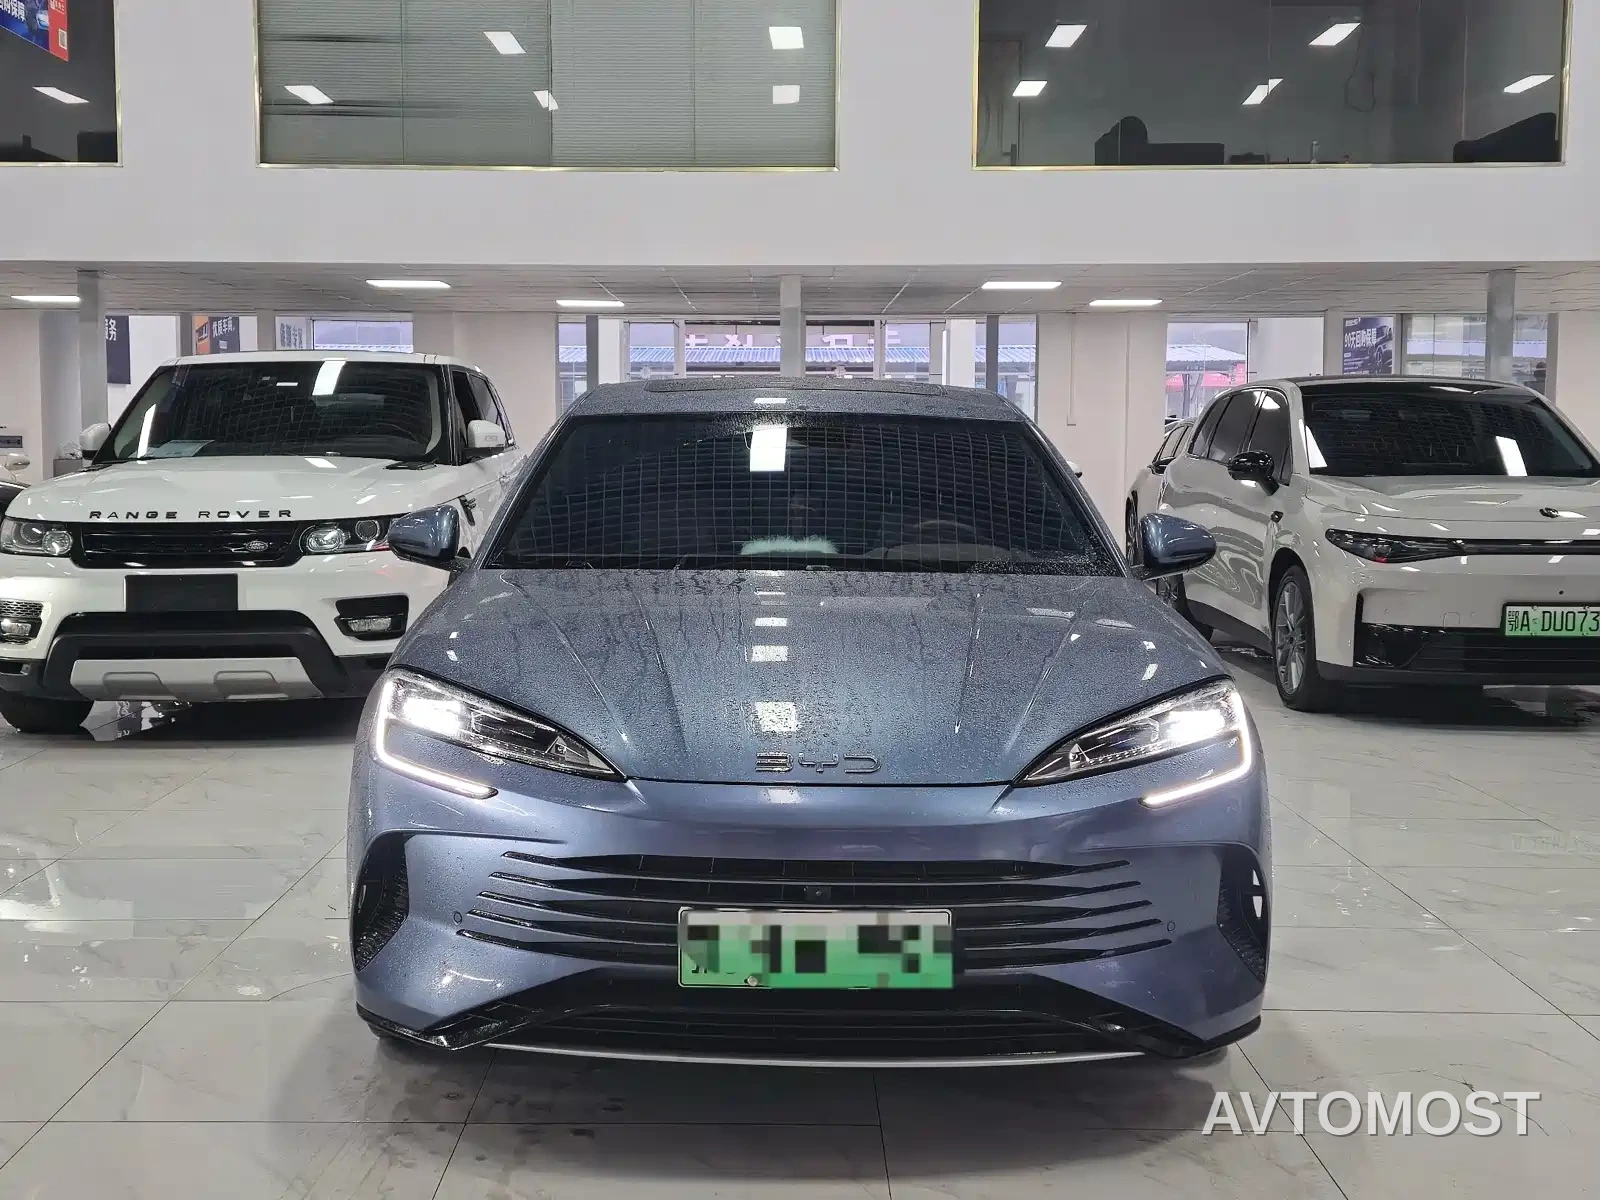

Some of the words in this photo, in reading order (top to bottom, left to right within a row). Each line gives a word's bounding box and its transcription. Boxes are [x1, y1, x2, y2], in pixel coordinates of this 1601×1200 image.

[89, 511, 178, 519] RANGE
[198, 510, 292, 519] ROVER
[755, 752, 881, 773] BYD
